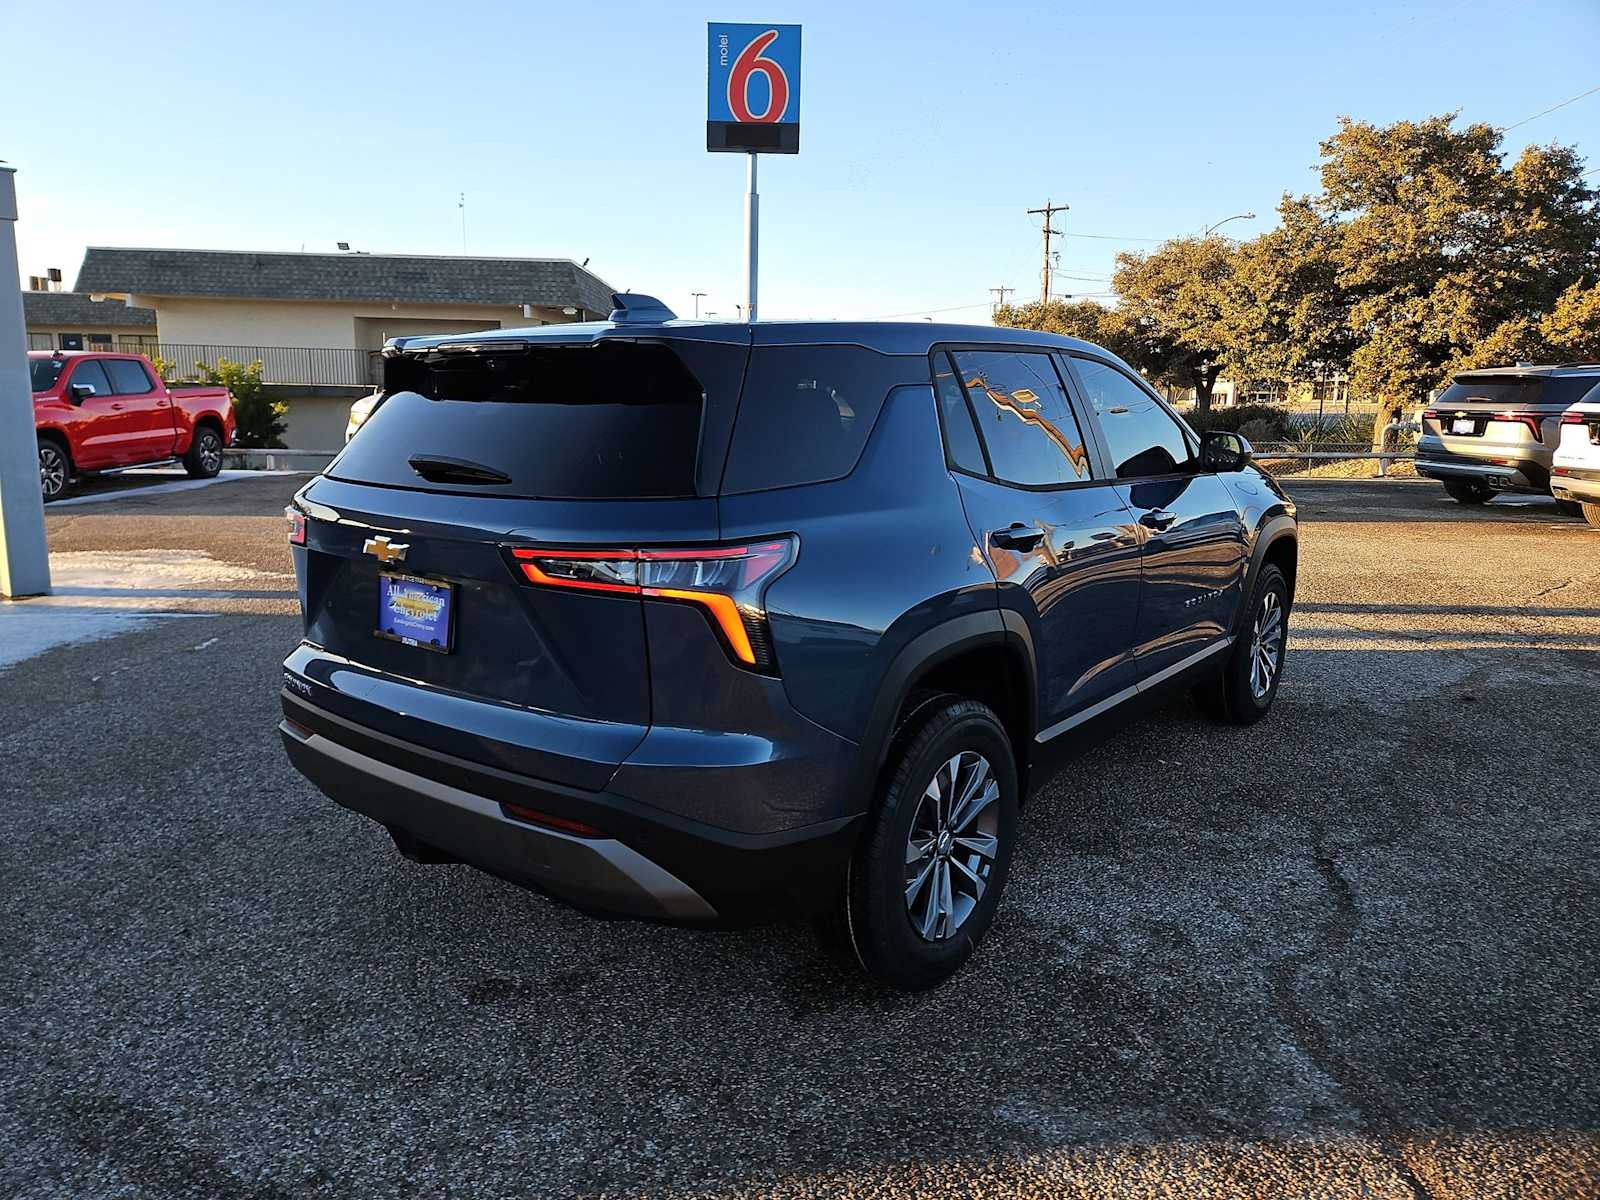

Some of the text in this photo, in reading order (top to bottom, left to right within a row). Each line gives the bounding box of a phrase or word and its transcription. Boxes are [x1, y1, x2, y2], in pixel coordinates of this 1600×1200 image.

[719, 34, 728, 66] motel
[727, 30, 789, 123] 6
[387, 584, 400, 597] All
